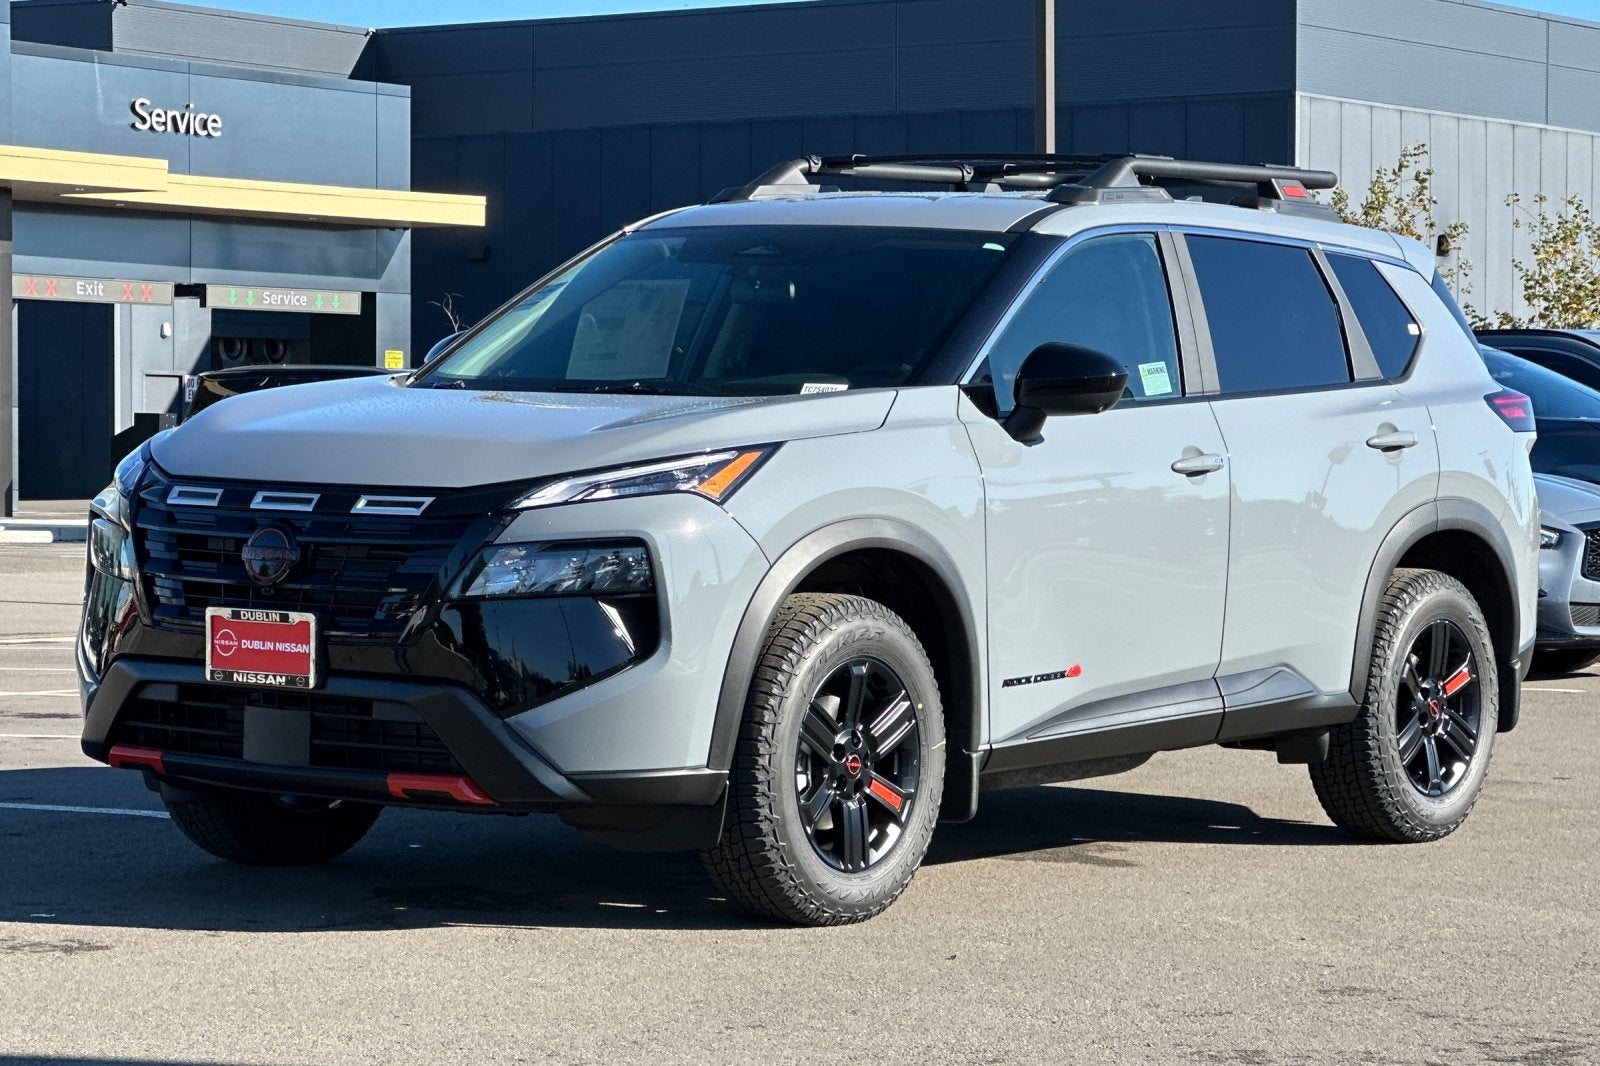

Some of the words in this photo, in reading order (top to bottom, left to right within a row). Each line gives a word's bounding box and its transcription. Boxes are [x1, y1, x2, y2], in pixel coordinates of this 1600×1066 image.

[134, 97, 223, 138] Service
[76, 281, 104, 297] Exit
[262, 291, 308, 306] Service
[1147, 366, 1167, 376] WARNING
[240, 610, 280, 622] DUBLIN
[241, 639, 274, 651] DUBLIN
[275, 642, 310, 654] NISSAN
[233, 672, 286, 686] NISSAN
